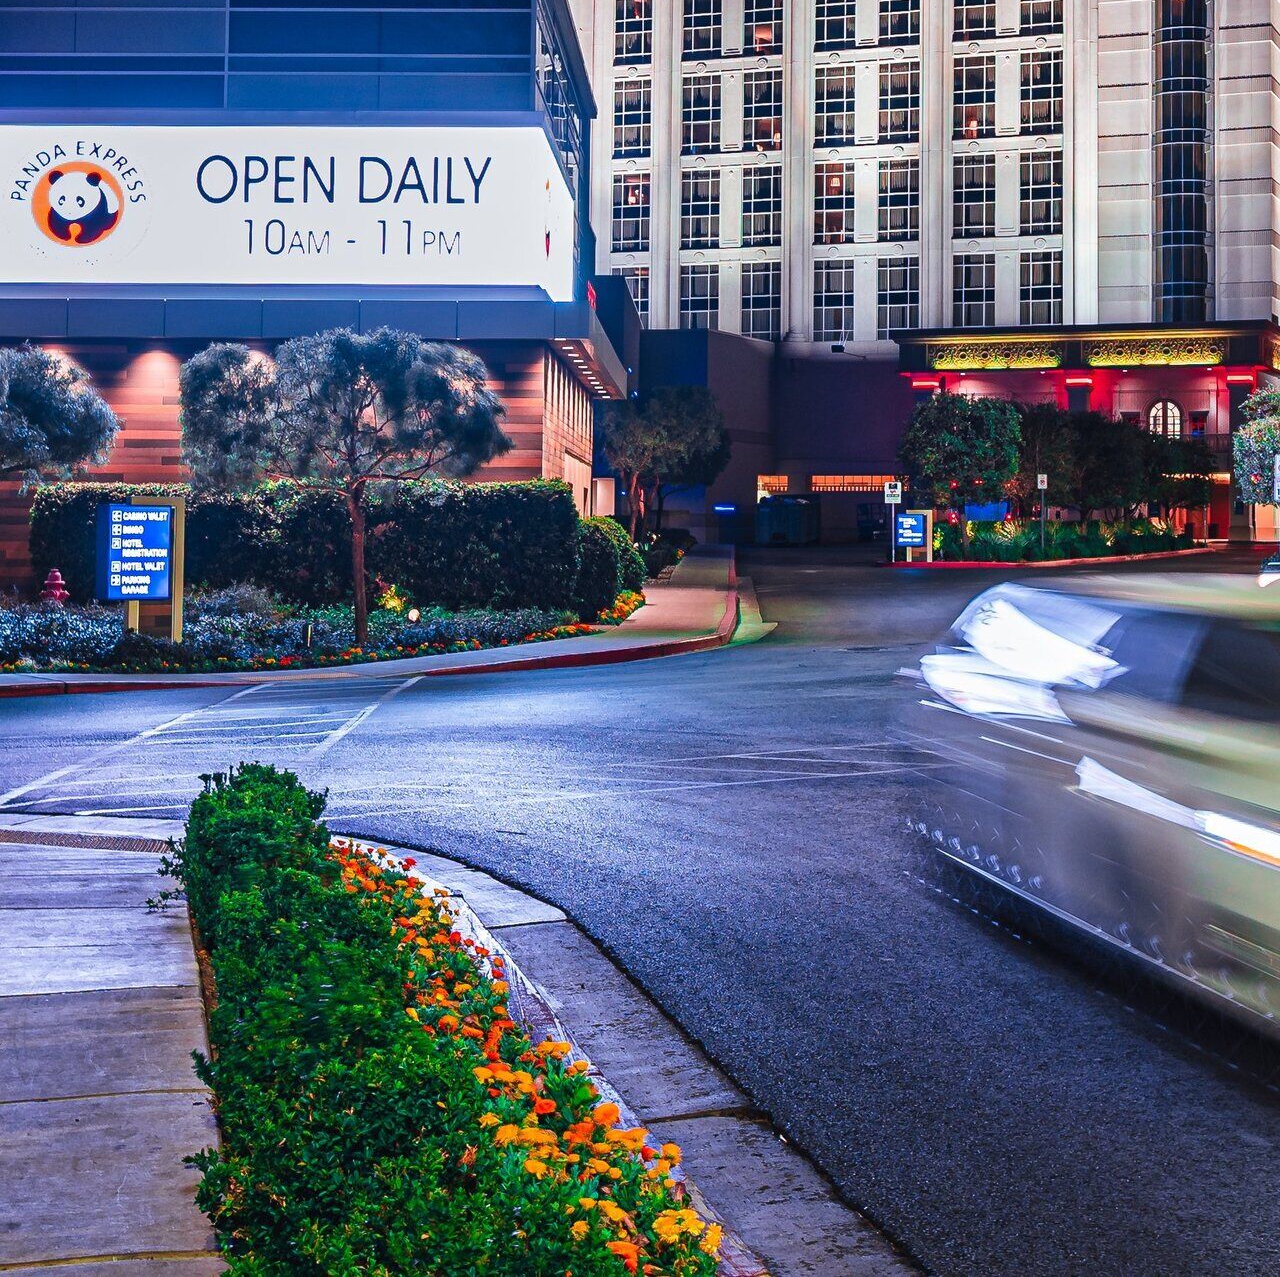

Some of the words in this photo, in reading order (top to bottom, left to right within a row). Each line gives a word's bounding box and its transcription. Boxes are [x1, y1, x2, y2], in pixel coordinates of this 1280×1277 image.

[10, 144, 66, 201] PANDA
[76, 140, 147, 203] EXPRESS
[197, 154, 335, 204] OPEN
[358, 156, 492, 204] DAILY
[122, 539, 143, 548] HOTEL
[122, 562, 144, 571] HOTEL
